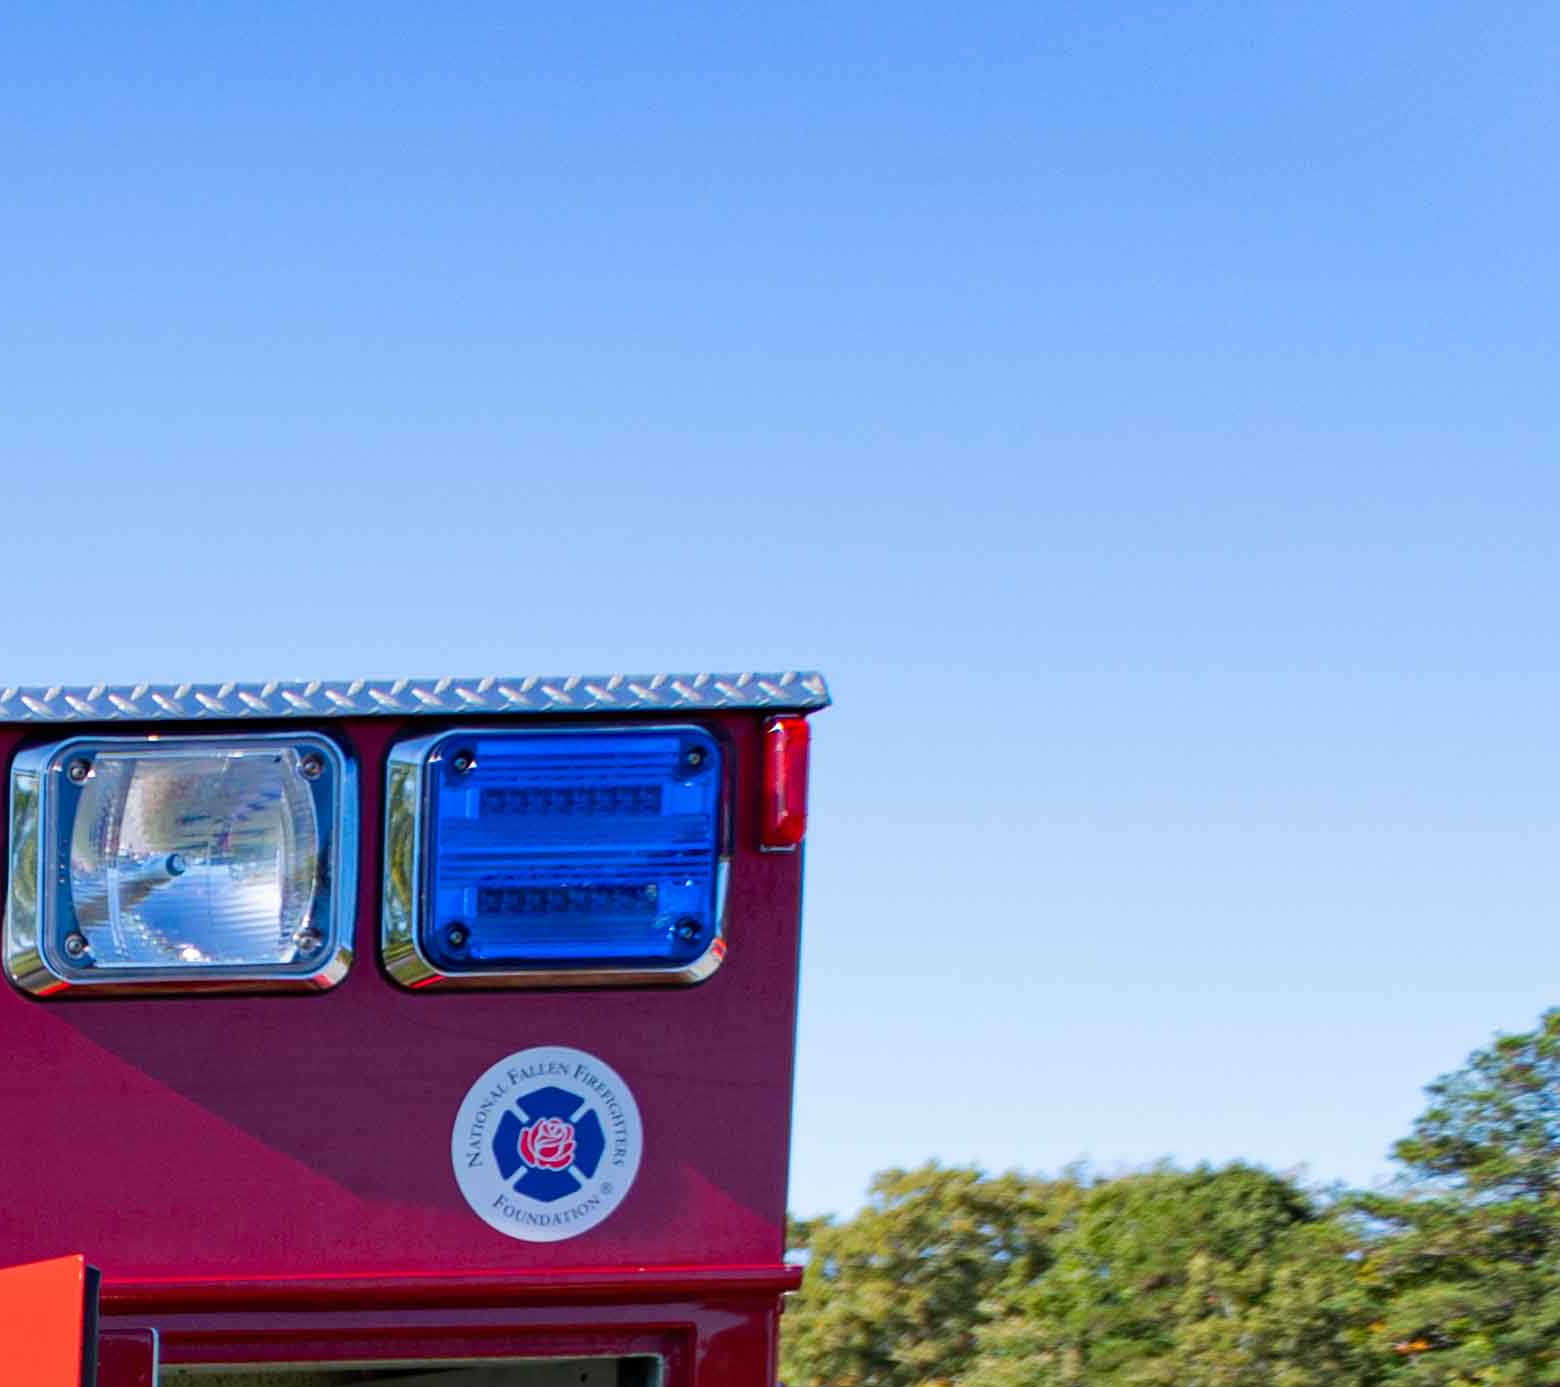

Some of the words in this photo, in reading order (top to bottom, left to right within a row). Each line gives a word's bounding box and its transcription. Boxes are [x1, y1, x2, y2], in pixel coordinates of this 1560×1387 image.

[466, 1083, 508, 1169] NATIONAL
[507, 1062, 571, 1086] FALLEN
[573, 1063, 628, 1167] FIREFIGHTERS
[492, 1194, 601, 1227] FOUNDATION
